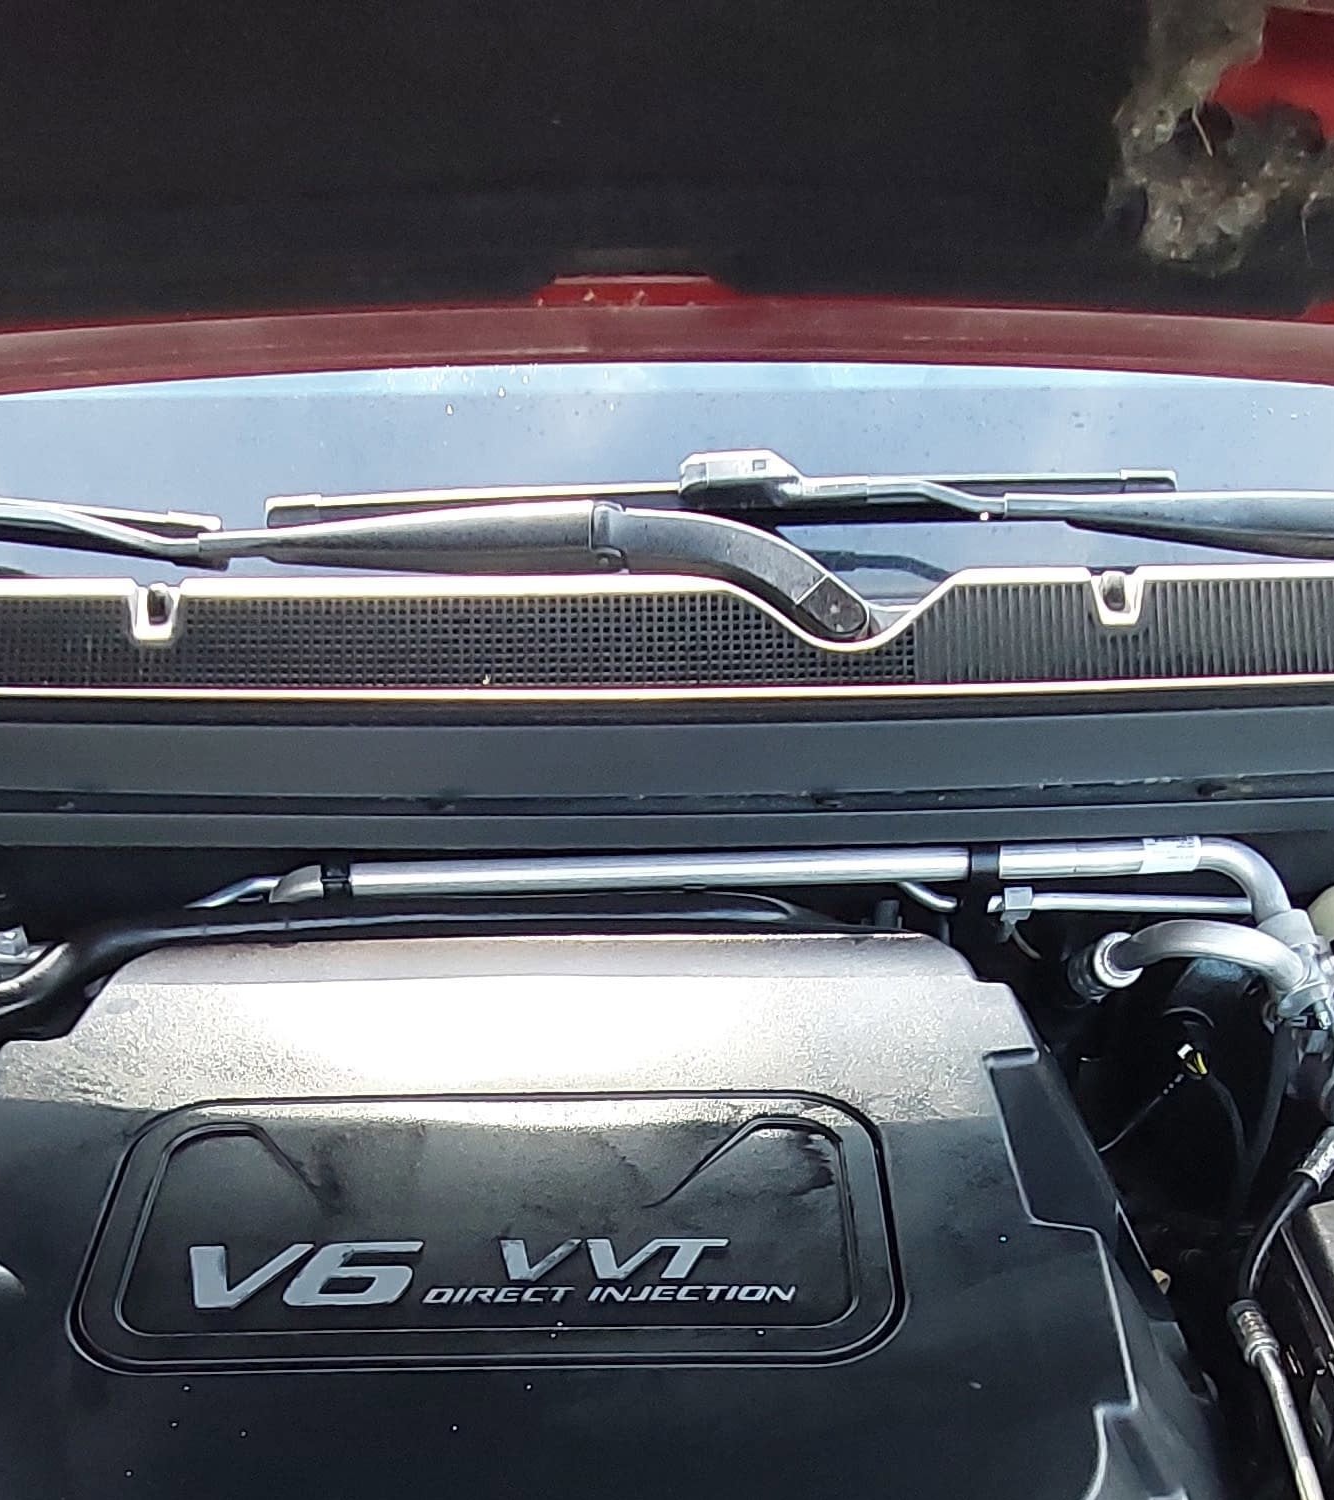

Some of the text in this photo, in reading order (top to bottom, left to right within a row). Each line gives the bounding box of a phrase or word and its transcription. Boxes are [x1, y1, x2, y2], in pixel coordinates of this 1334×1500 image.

[189, 1238, 729, 1308] V6 VVT
[422, 1285, 797, 1304] DIRECT INJECTION
